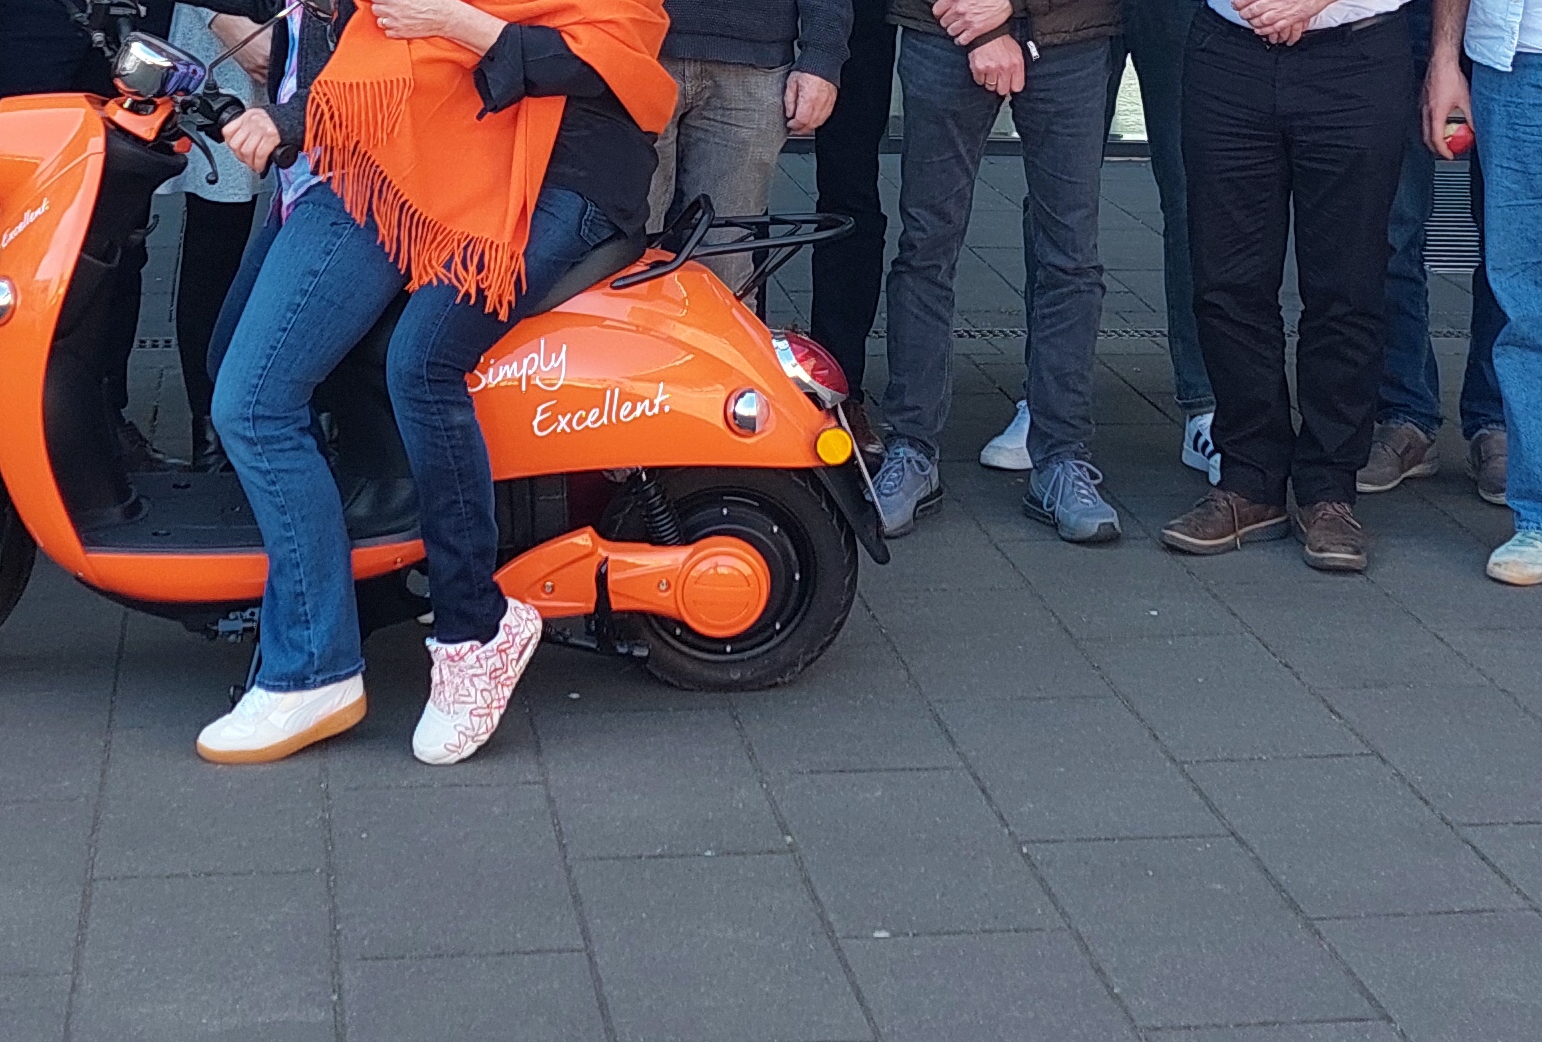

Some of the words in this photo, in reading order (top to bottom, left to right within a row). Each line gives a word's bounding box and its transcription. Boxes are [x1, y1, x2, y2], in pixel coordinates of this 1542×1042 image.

[1, 197, 50, 249] Excellent.
[467, 337, 567, 394] Simply
[532, 381, 671, 437] Excellent.
